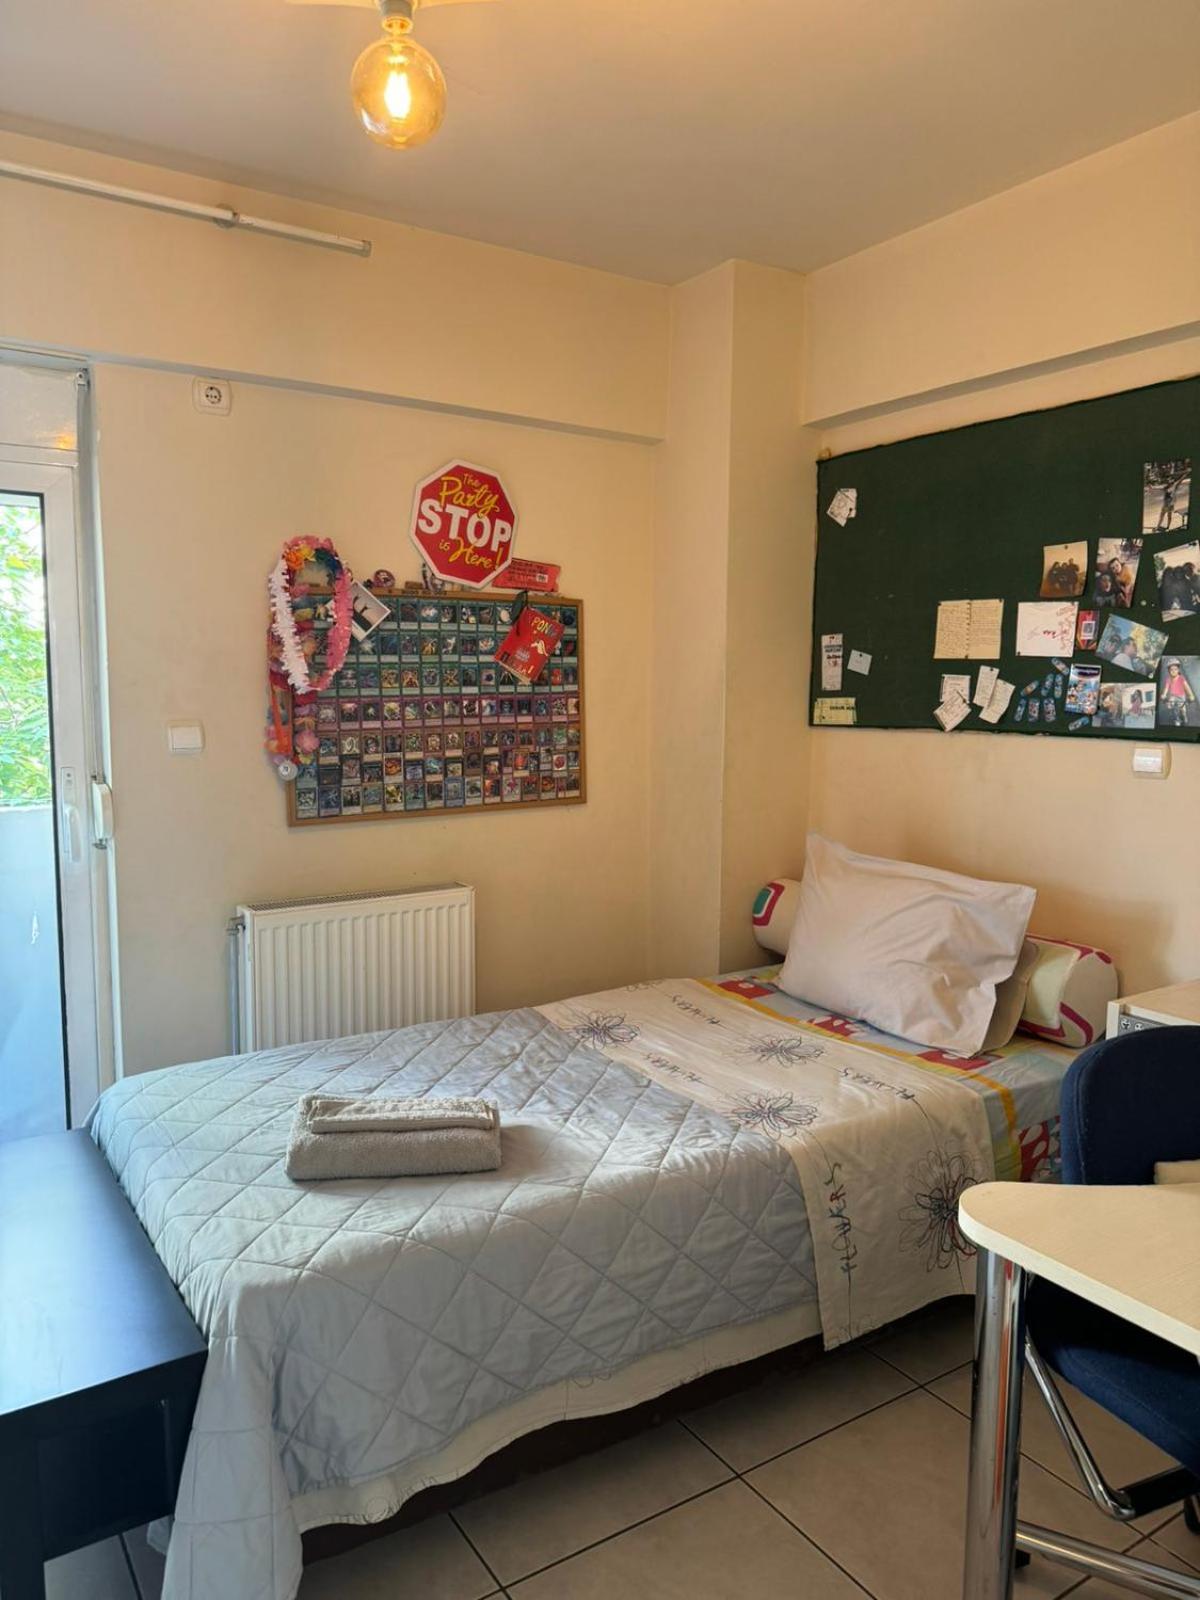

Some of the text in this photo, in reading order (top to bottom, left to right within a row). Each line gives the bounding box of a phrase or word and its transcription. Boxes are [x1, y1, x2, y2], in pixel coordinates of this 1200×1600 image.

[439, 475, 500, 519] Party
[462, 472, 482, 488] The
[418, 499, 512, 552] STOP
[438, 535, 503, 572] is Here!
[824, 1161, 857, 1274] FLOWERS
